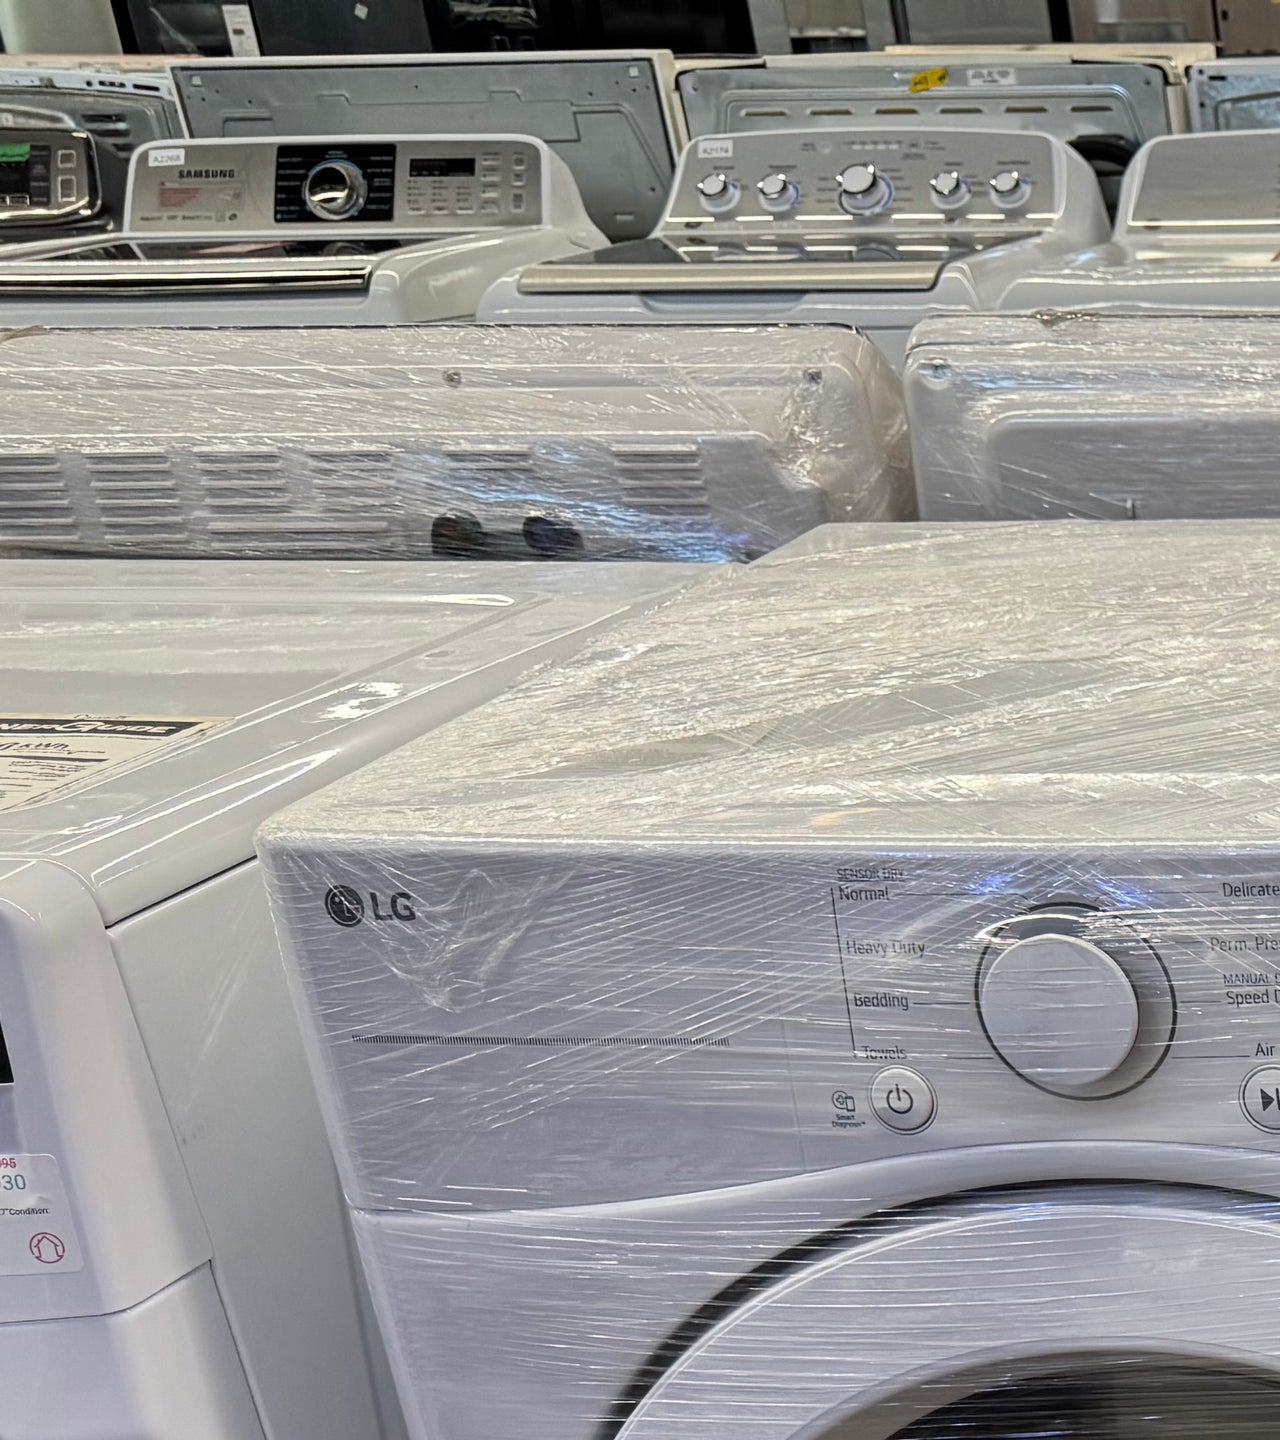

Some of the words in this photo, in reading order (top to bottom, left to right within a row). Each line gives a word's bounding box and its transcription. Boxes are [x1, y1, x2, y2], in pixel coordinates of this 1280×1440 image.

[178, 169, 235, 179] SAMSUNG
[839, 886, 889, 901] Normal
[371, 891, 417, 922] LG
[846, 940, 888, 958] Heavy
[892, 940, 926, 958] Duty
[1210, 937, 1250, 951] Perm.
[1223, 973, 1270, 985] MANUAL
[854, 992, 909, 1011] Bedding
[1226, 990, 1270, 1007] Speed
[861, 1045, 908, 1060] Towels
[1255, 1042, 1275, 1057] Air
[0, 1174, 26, 1190] 30
